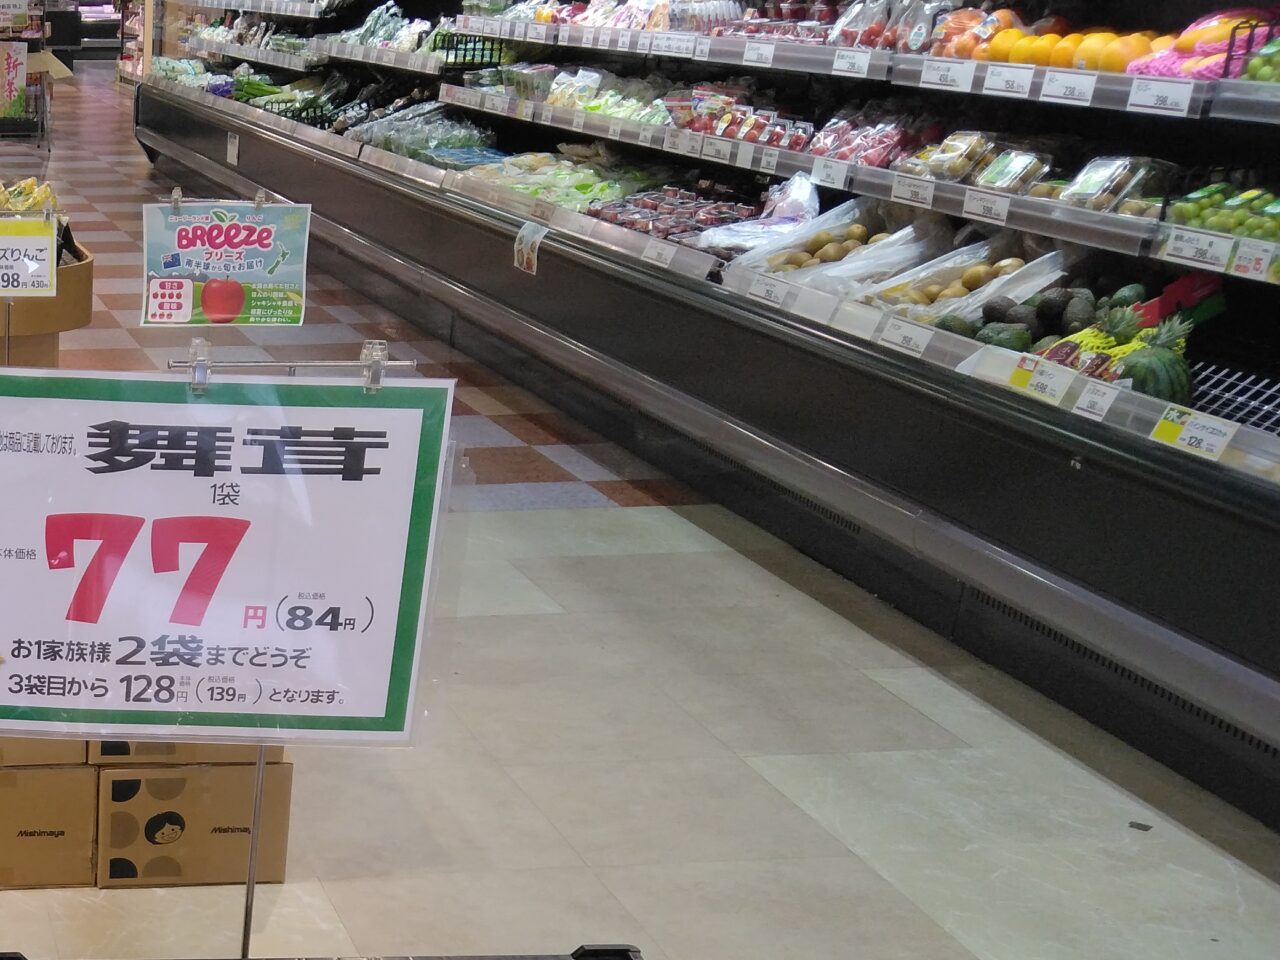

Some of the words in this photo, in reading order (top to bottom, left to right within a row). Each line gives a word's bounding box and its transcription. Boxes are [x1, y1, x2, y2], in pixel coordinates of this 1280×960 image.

[204, 251, 245, 261] ブリーズ
[85, 419, 390, 482] 舞茸
[210, 482, 240, 507] 1袋
[297, 591, 326, 600] 税込価格
[17, 829, 65, 838] Mishimaya
